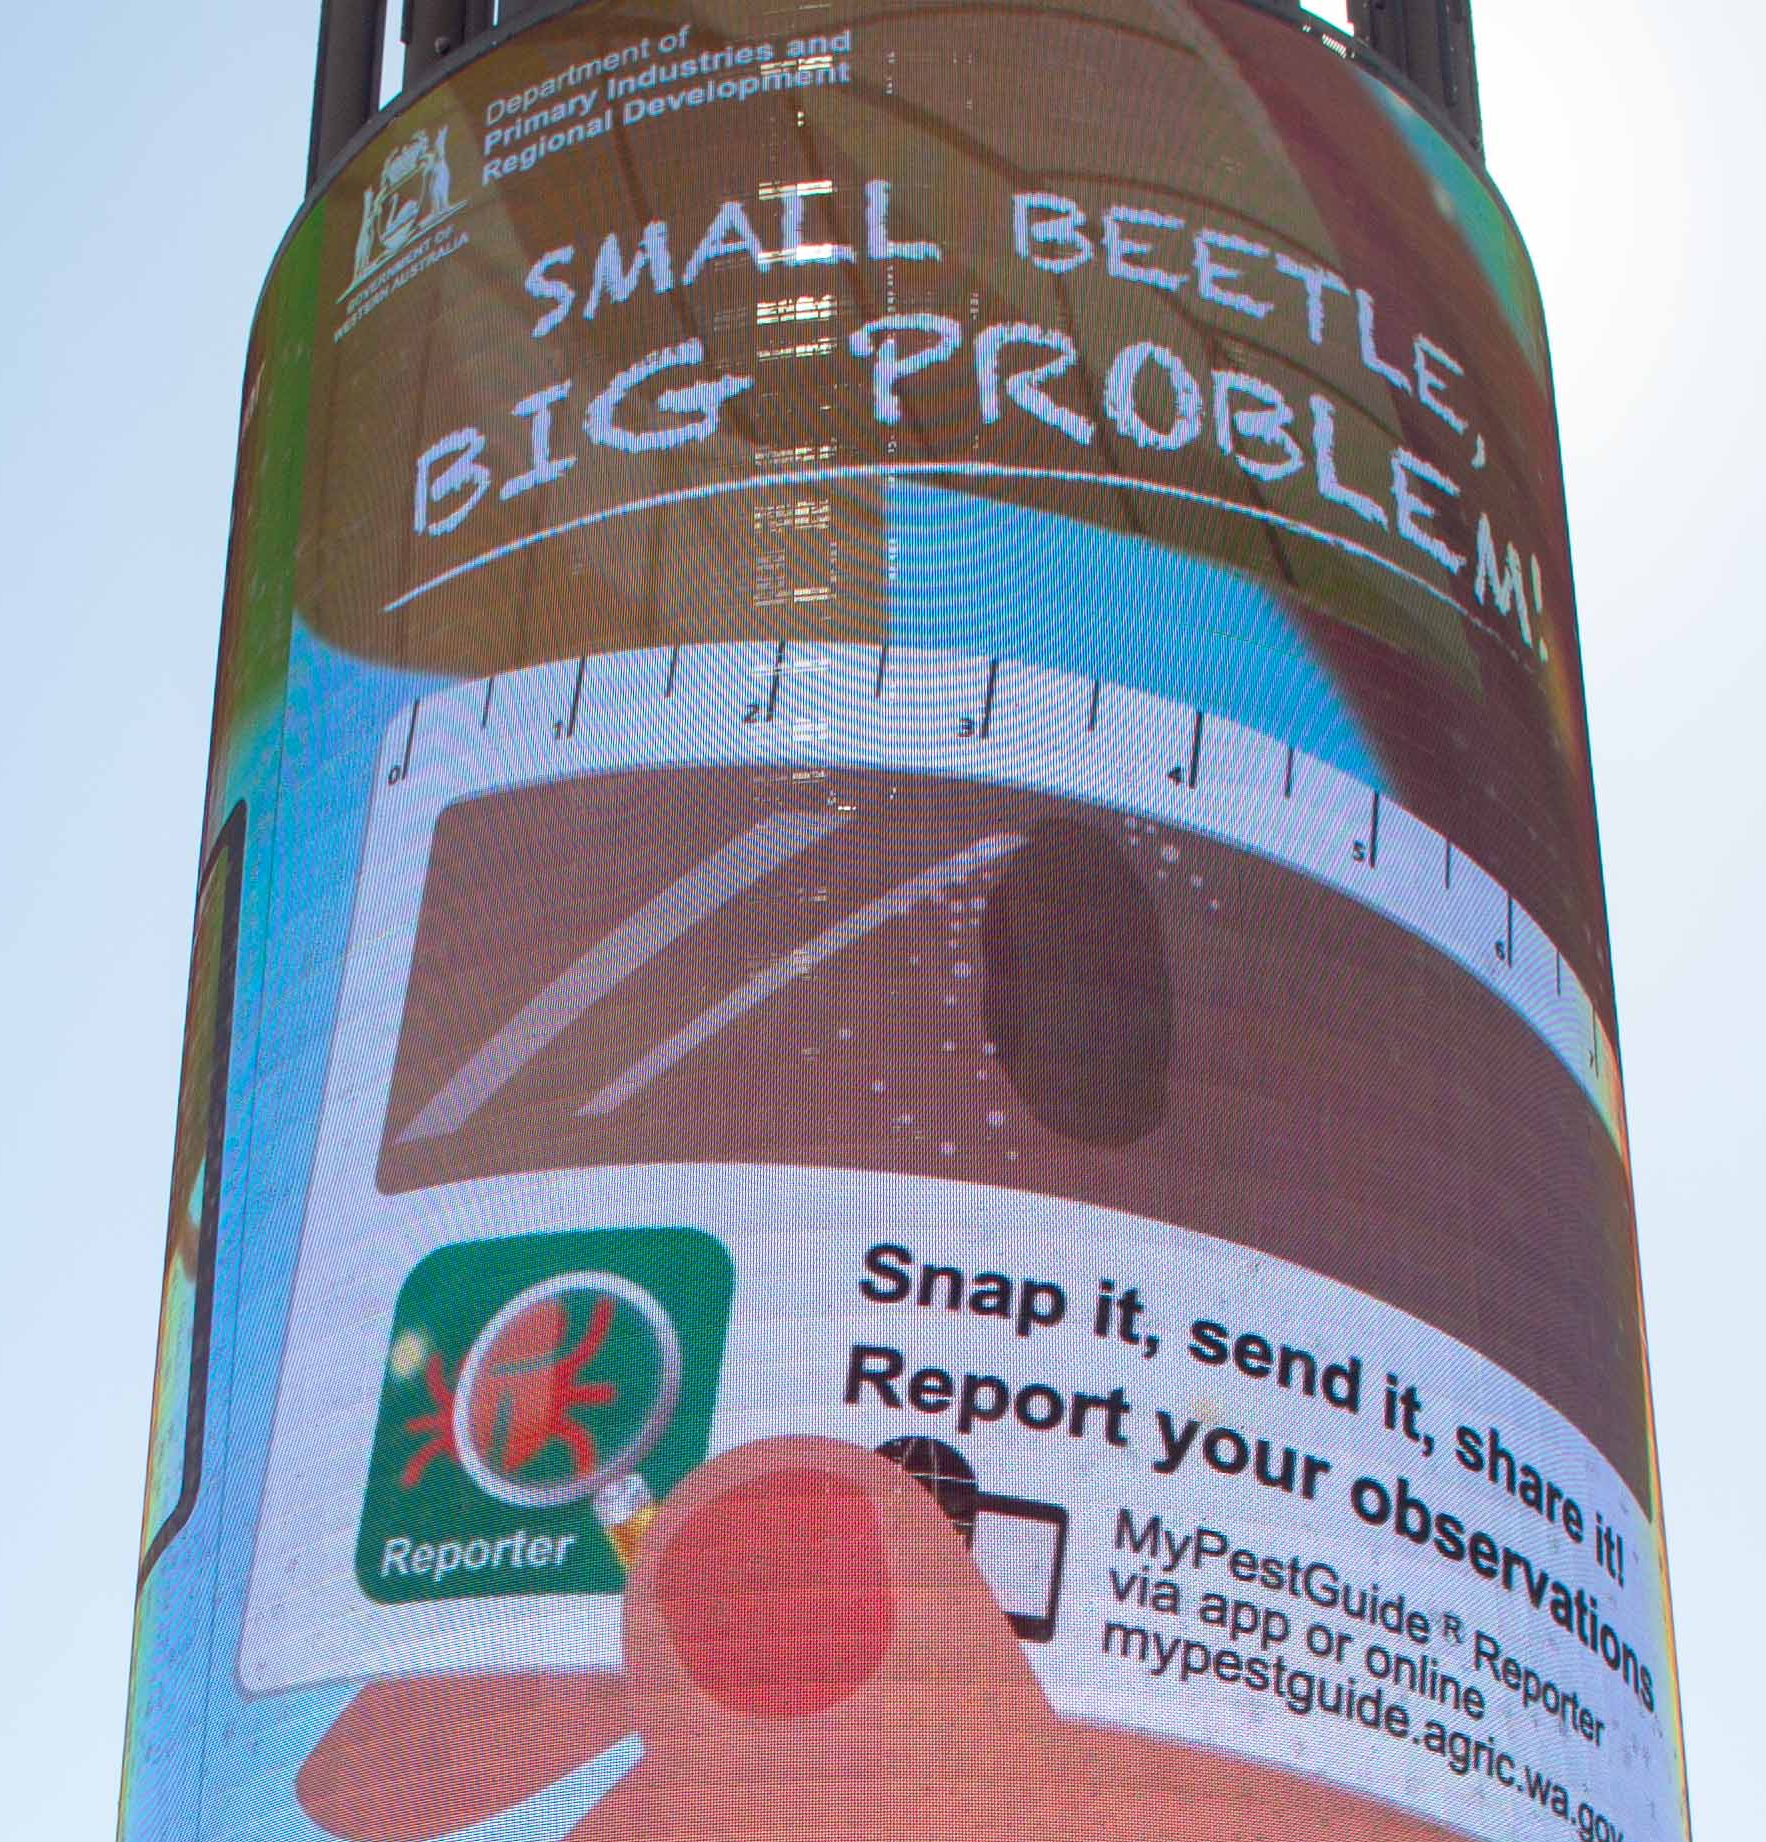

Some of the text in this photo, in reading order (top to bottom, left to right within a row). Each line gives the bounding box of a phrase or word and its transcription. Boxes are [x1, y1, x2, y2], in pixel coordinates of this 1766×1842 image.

[481, 61, 851, 187] Regional Development
[482, 30, 851, 155] Primary Industries and
[486, 25, 691, 127] Department of
[392, 231, 471, 291] AUSTRALIA
[524, 178, 1487, 470] SMALL BEETLE,
[413, 312, 1550, 662] BIG PROBLEM!
[858, 1242, 1626, 1588] Snap it, send it, share it!
[380, 1529, 578, 1583] Reporter
[844, 1343, 1656, 1714] Report your observations
[1109, 1566, 1486, 1722] via app or online
[1114, 1507, 1430, 1645] MyPestGuide
[1473, 1629, 1606, 1747] Reporter
